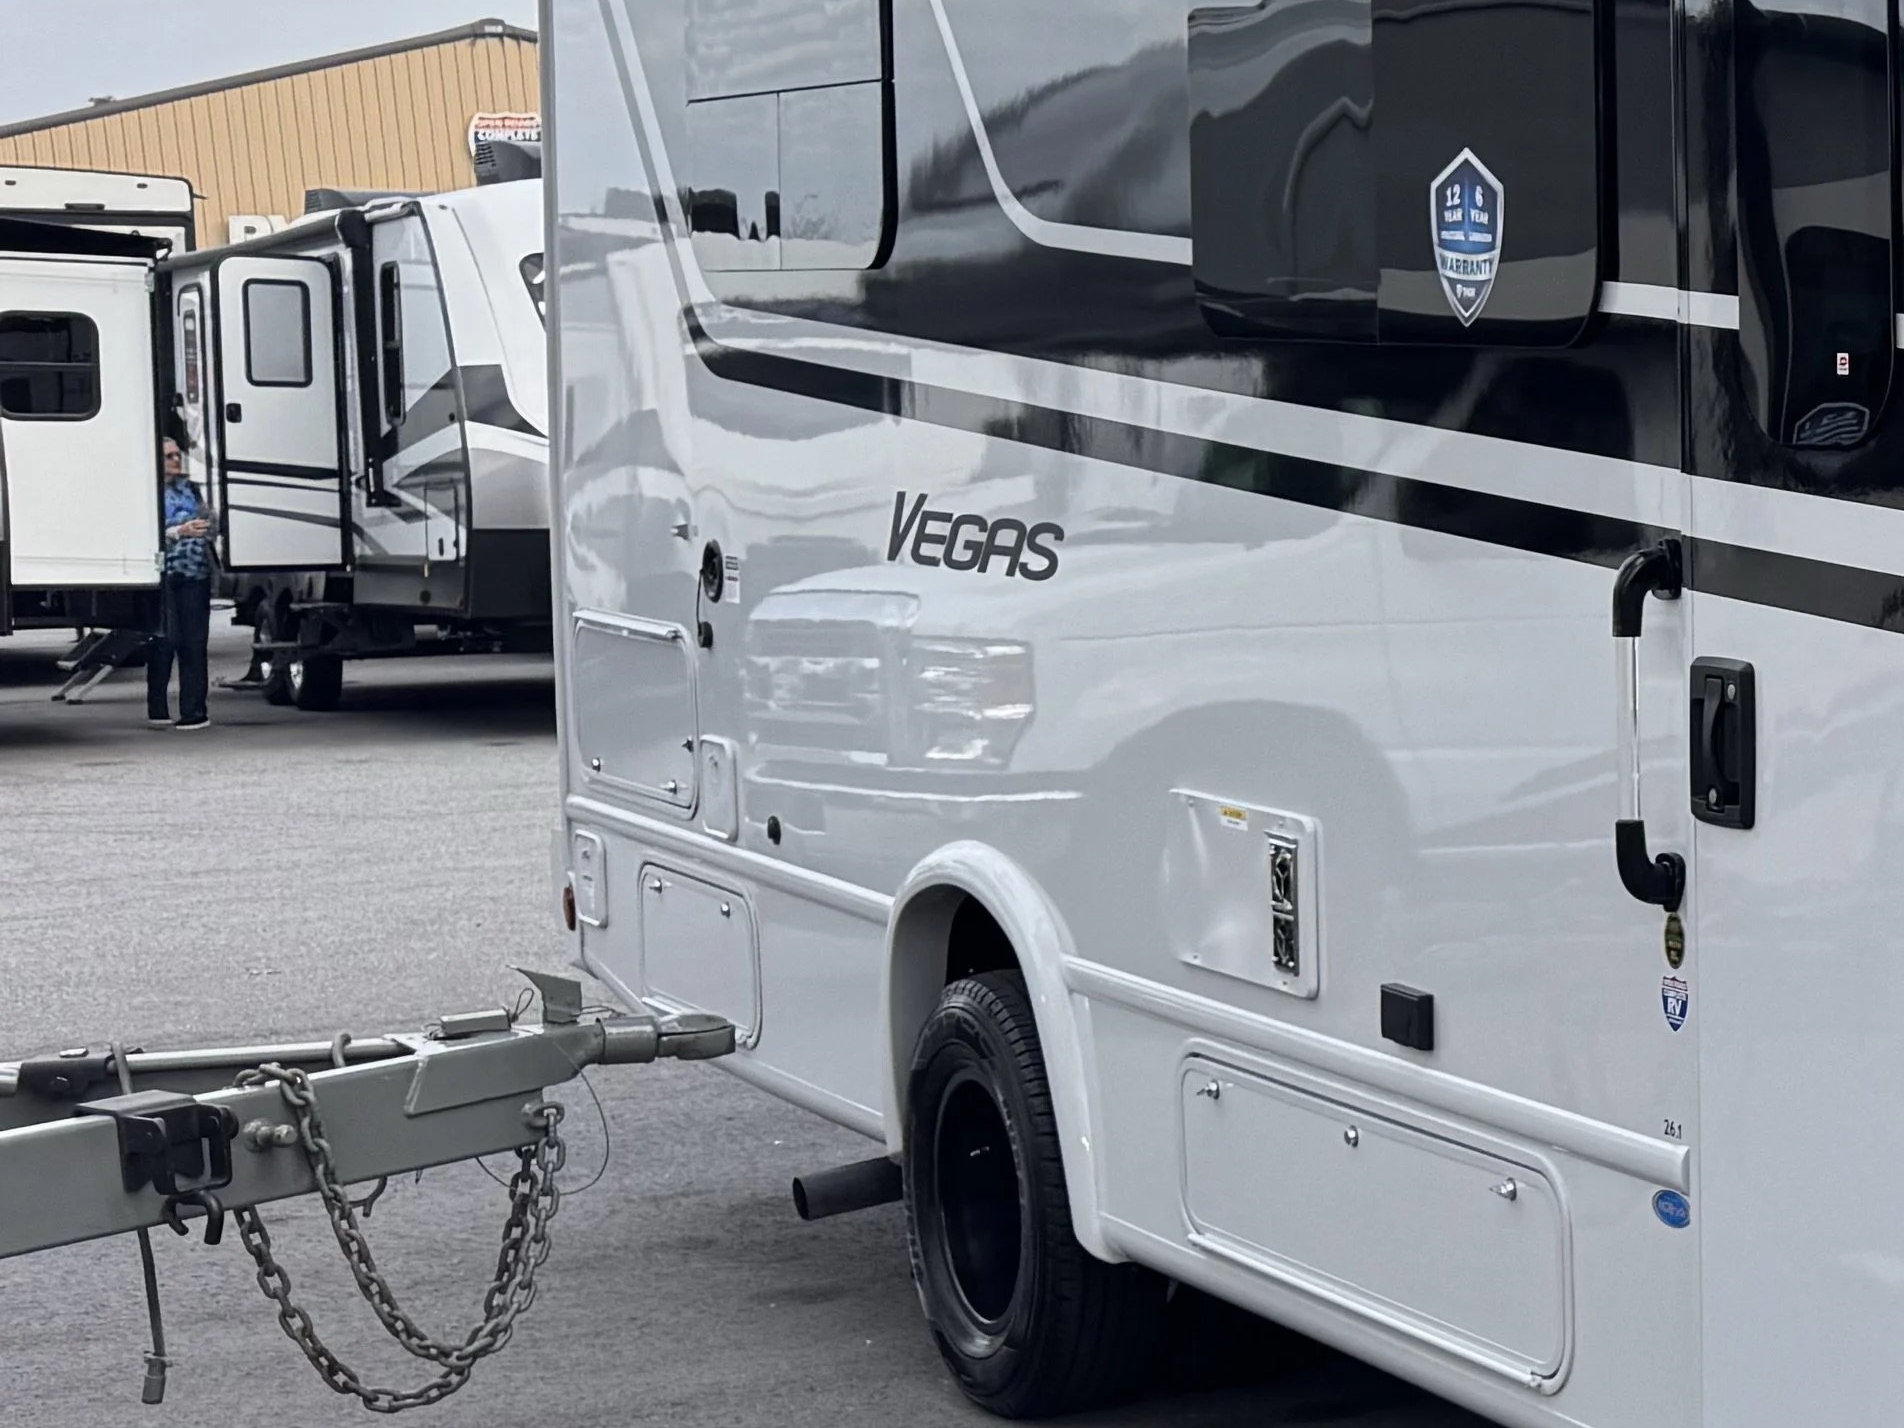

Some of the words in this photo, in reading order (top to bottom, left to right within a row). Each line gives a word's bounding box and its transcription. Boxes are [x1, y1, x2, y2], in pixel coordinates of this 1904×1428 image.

[1446, 184, 1461, 207] 12
[1474, 185, 1484, 208] 6
[1443, 208, 1463, 223] YEAR
[1470, 208, 1489, 225] YEAR
[1440, 256, 1494, 277] WARRANTY
[887, 491, 1065, 581] VEGAS
[1667, 997, 1682, 1016] RV
